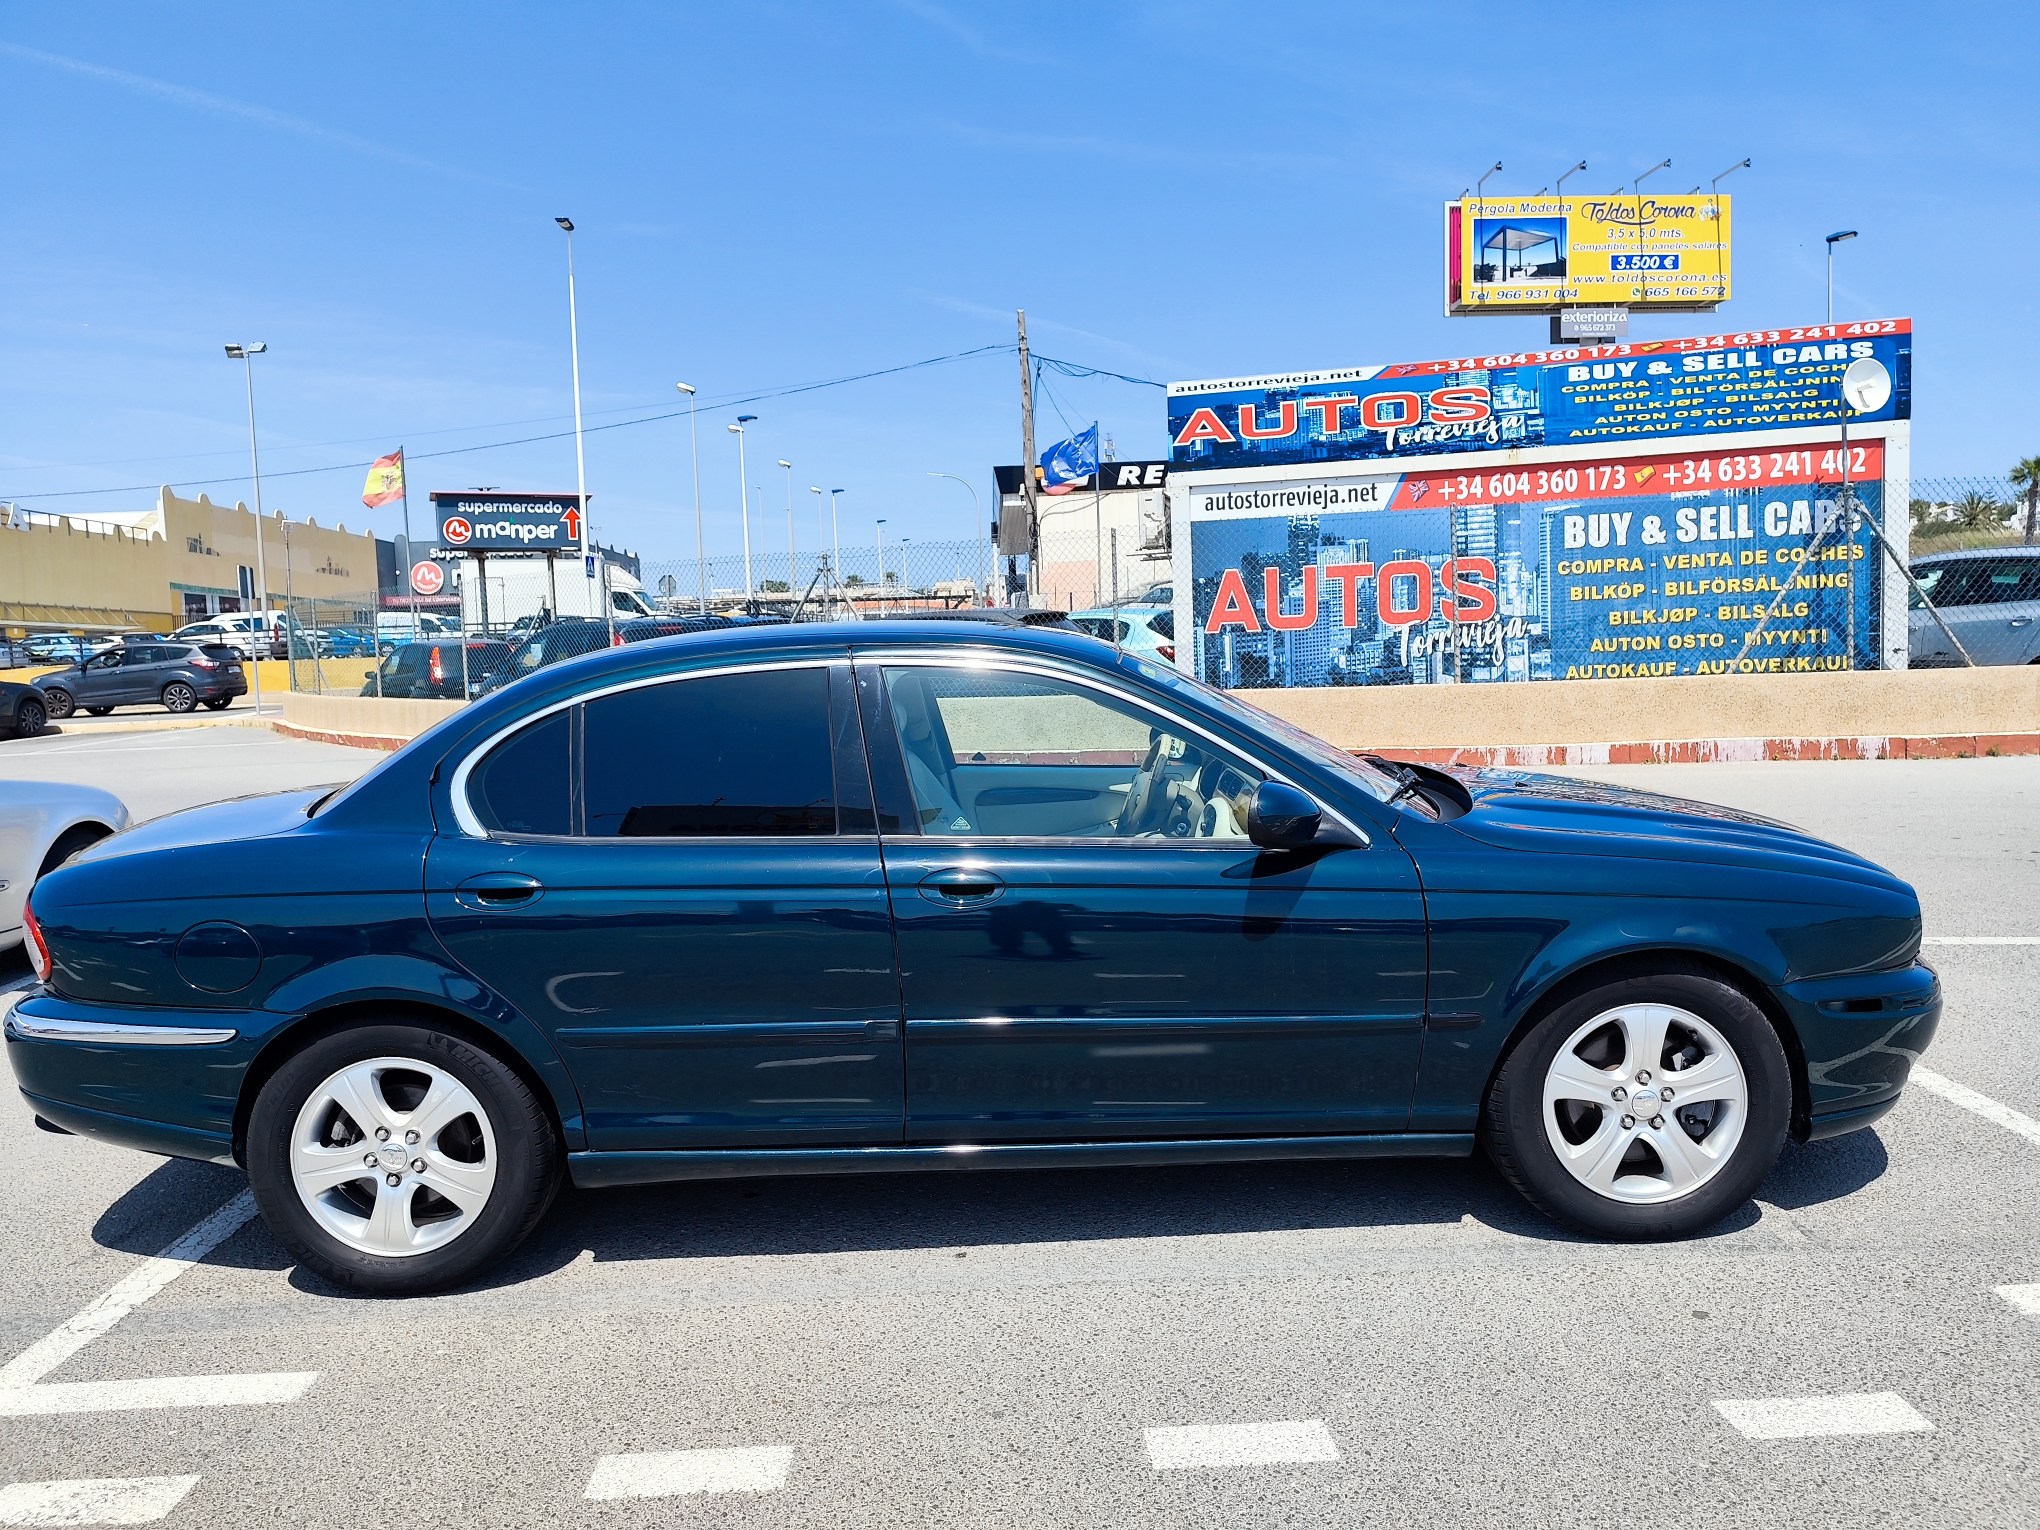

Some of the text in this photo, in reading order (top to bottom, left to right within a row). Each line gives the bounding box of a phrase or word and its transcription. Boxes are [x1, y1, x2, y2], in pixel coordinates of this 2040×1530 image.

[1469, 203, 1572, 216] Pergola Moderna
[1581, 200, 1696, 224] Toldos Corona
[1607, 228, 1684, 239] 3,5 x 5,0 mts.
[1572, 242, 1628, 252] Compatible
[1651, 243, 1689, 251] paneles
[1616, 256, 1675, 269] 3.500 €
[1573, 273, 1727, 284] www.toldoscorona.es
[1470, 289, 1578, 300] Tel. 966 931 004
[1645, 286, 1726, 297] 665 166 572
[1561, 310, 1628, 323] exterioriza
[1580, 323, 1592, 332] 965
[1605, 323, 1616, 331] 373
[1672, 321, 1897, 350] +34 633 241 402
[1427, 344, 1632, 372] +34 604 360 173
[1568, 341, 1874, 382] BUY & SELL CARS
[1175, 369, 1363, 393] autostorrevieja.net
[1560, 379, 1650, 394] COMPRA
[1669, 371, 1741, 385] VENTA
[1747, 367, 1777, 379] DE
[1784, 363, 1848, 375] COCH
[1573, 388, 1651, 404] BILKÖP
[1670, 376, 1842, 397] BILFÖRSÄLJNIN
[1594, 410, 1668, 425] AUTON
[1675, 406, 1732, 420] OSTO
[1752, 399, 1839, 413] MYYNTI
[1613, 396, 1706, 412] BILKJØP
[1725, 389, 1819, 403] BILSALG
[1173, 386, 1493, 447] AUTOS
[1378, 415, 1524, 451] Torrevieja
[1568, 421, 1684, 438] AUTOKAUF
[1662, 447, 1866, 487] +34 633 241 402
[1437, 465, 1626, 500] +34 604 360 173
[457, 500, 563, 516] supermercado
[1204, 483, 1378, 513] autostorrevieja.net
[475, 520, 559, 544] manper
[1563, 511, 1633, 549] BUY
[1641, 515, 1667, 545] &
[1675, 505, 1754, 543] SELL
[1557, 556, 1645, 576] COMPRA
[1663, 550, 1734, 571] VENTA
[1740, 549, 1768, 565] DE
[1204, 556, 1498, 634] AUTOS
[1570, 581, 1646, 602] BILKÖP
[1665, 572, 1849, 597] BILFÖRSÄLNING
[1609, 606, 1698, 627] BILKJØP
[1397, 614, 1528, 667] Torrvieja
[1590, 635, 1661, 654] AUTON
[1668, 631, 1724, 650] OSTO
[1566, 660, 1677, 680] AUTOKAUF
